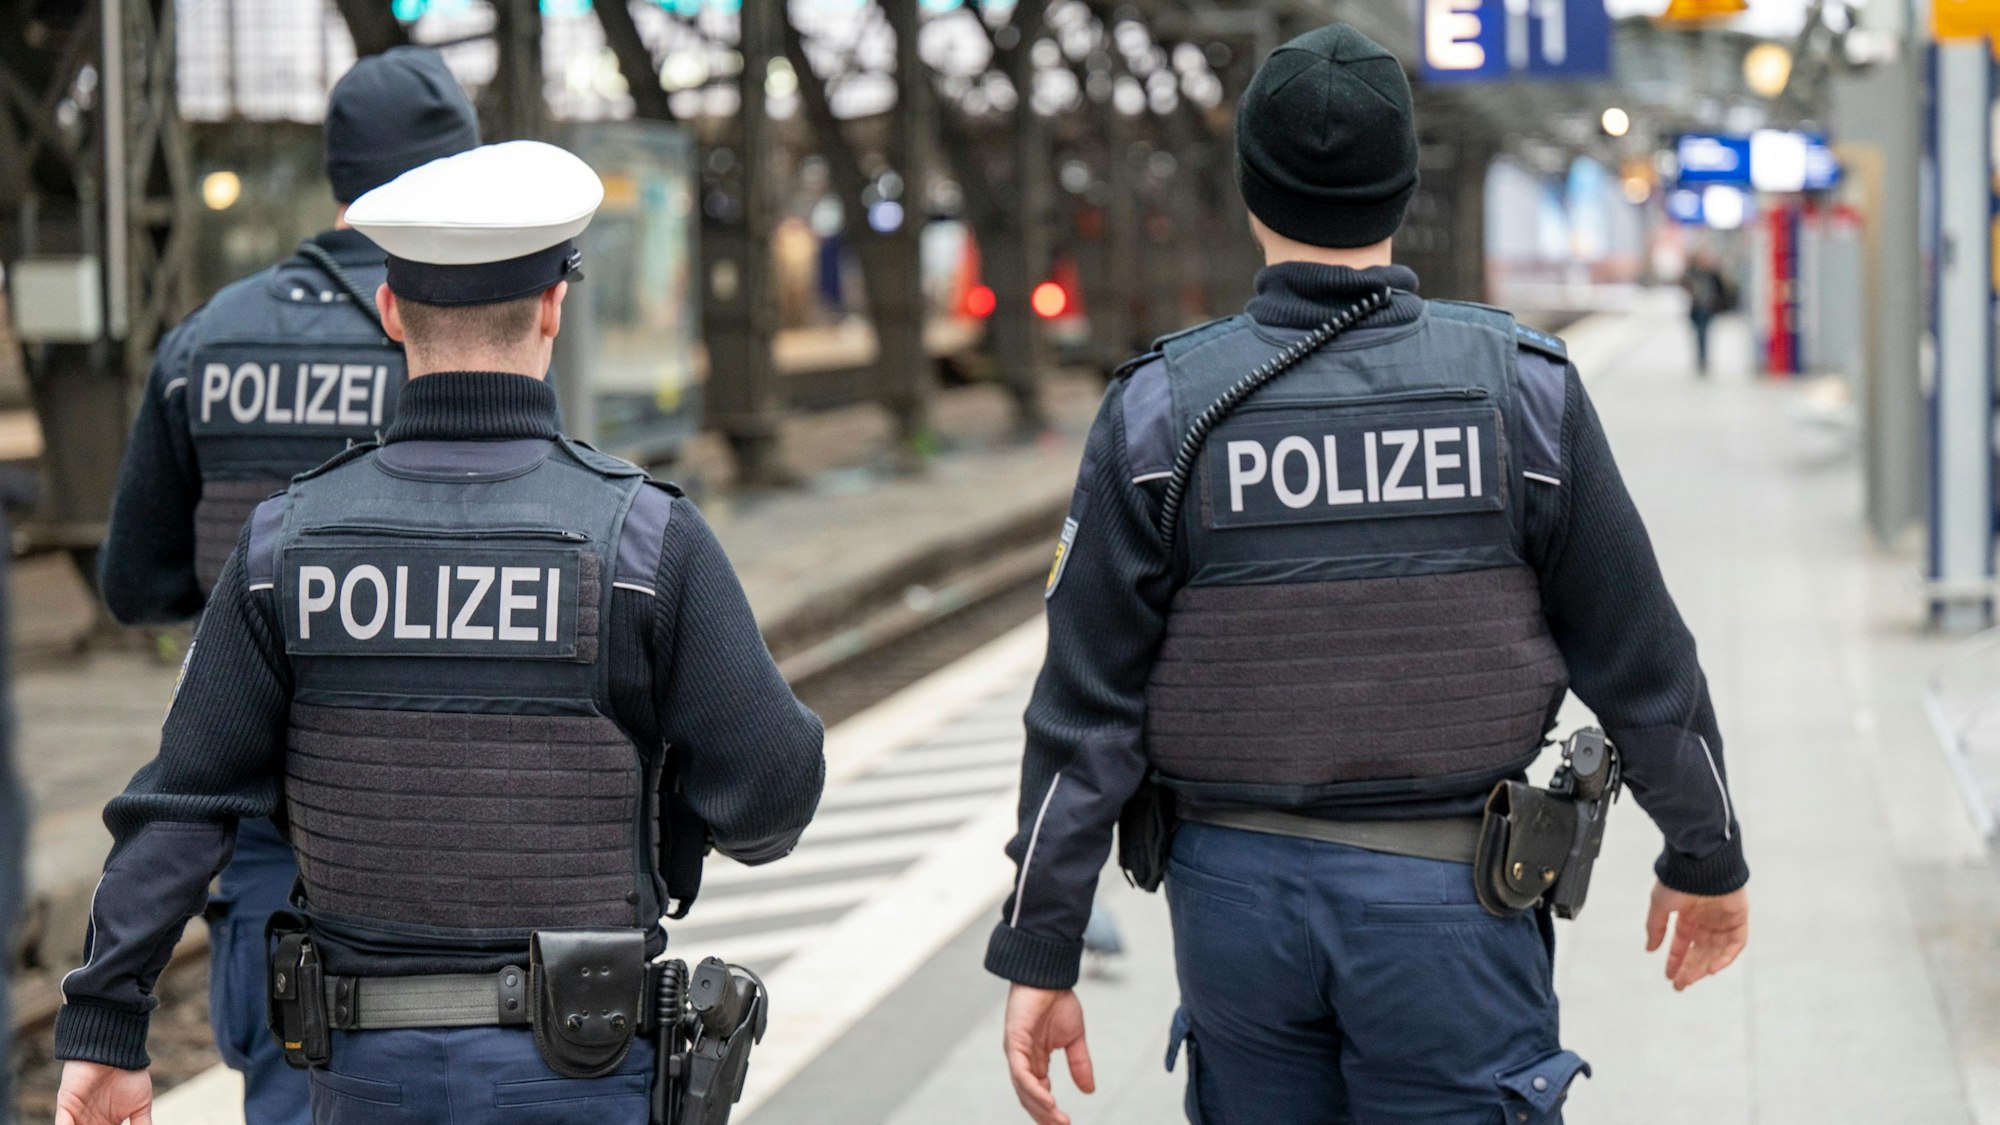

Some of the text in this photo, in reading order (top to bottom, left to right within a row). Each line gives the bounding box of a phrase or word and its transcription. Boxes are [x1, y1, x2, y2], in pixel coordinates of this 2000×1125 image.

[1424, 0, 1485, 70] E
[201, 362, 388, 426] POLIZEI
[1227, 426, 1482, 512] POLIZEI
[299, 564, 560, 642] POLIZEI
